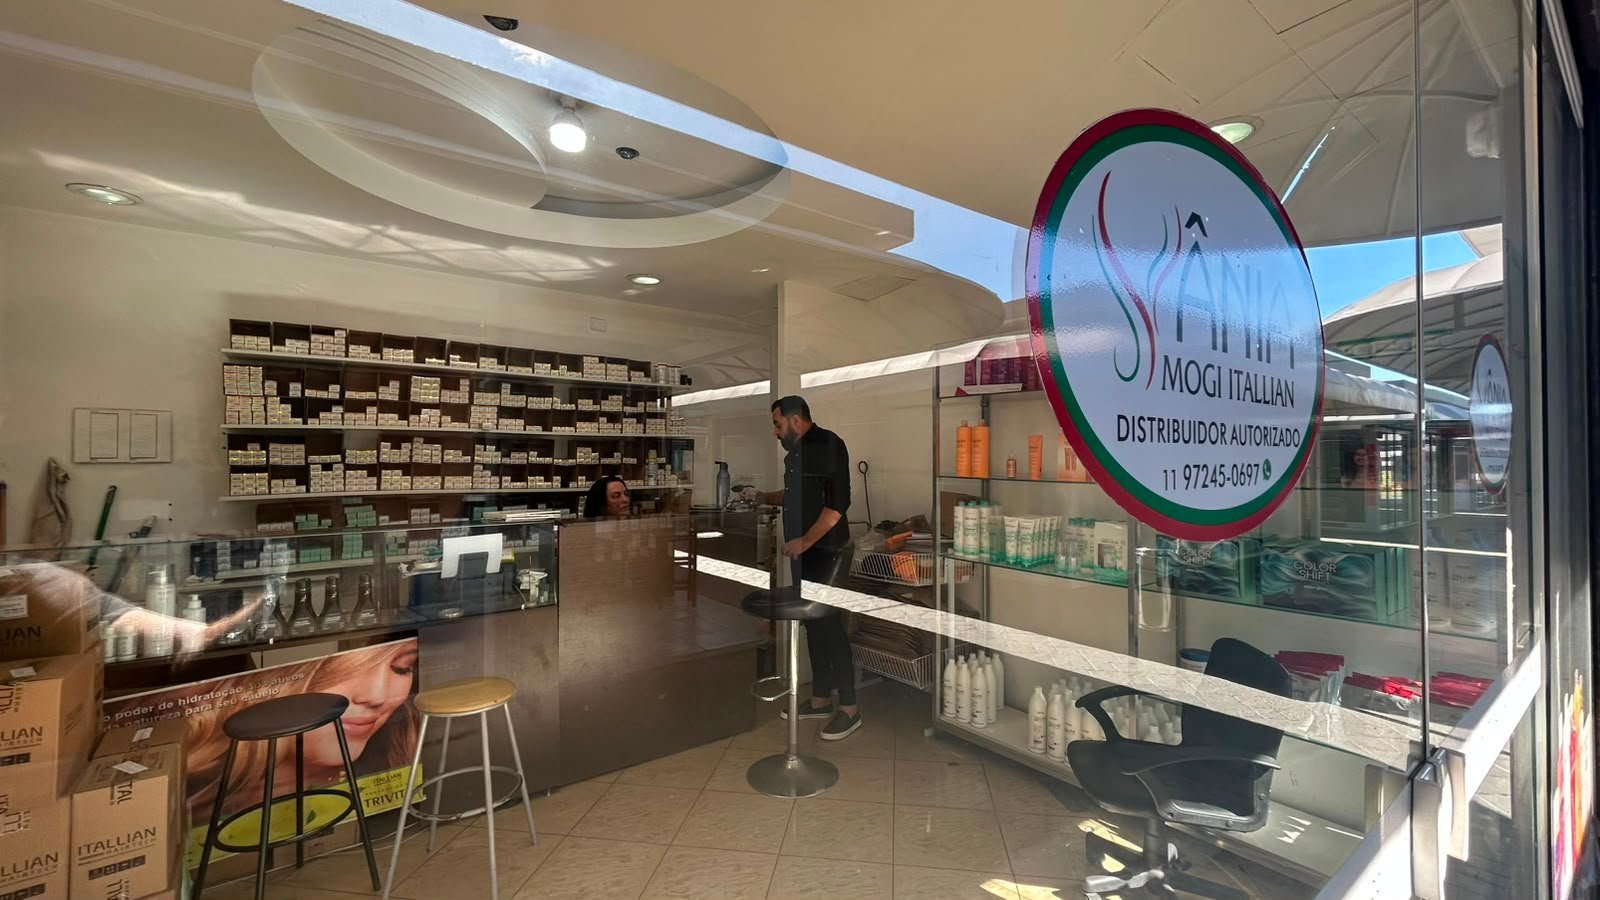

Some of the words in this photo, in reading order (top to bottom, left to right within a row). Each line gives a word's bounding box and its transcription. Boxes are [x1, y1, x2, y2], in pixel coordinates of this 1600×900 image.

[1161, 354, 1222, 399] MOGI
[1229, 368, 1295, 409] ITALLIAN
[1117, 414, 1228, 446] DISTRIBUIDOR
[1230, 424, 1300, 448] AUTORIZADO
[1163, 469, 1177, 491] 11
[1183, 463, 1260, 491] 97245-0697
[1179, 548, 1211, 559] COLOR
[1183, 556, 1207, 566] SHIFT
[1294, 560, 1337, 573] COLOR
[1298, 570, 1331, 582] SHIFT
[115, 706, 154, 721] poder
[158, 701, 174, 711] de
[178, 686, 243, 706] hidratação
[271, 671, 305, 685] ativos
[124, 711, 181, 728] natureza
[185, 704, 213, 717] para
[217, 699, 238, 710] seu
[241, 687, 280, 702] cabelo
[0, 726, 43, 742] LIAN
[363, 790, 405, 808] TRIVIT
[78, 827, 157, 856] ITALLIAN
[0, 852, 59, 875] LLIAN
